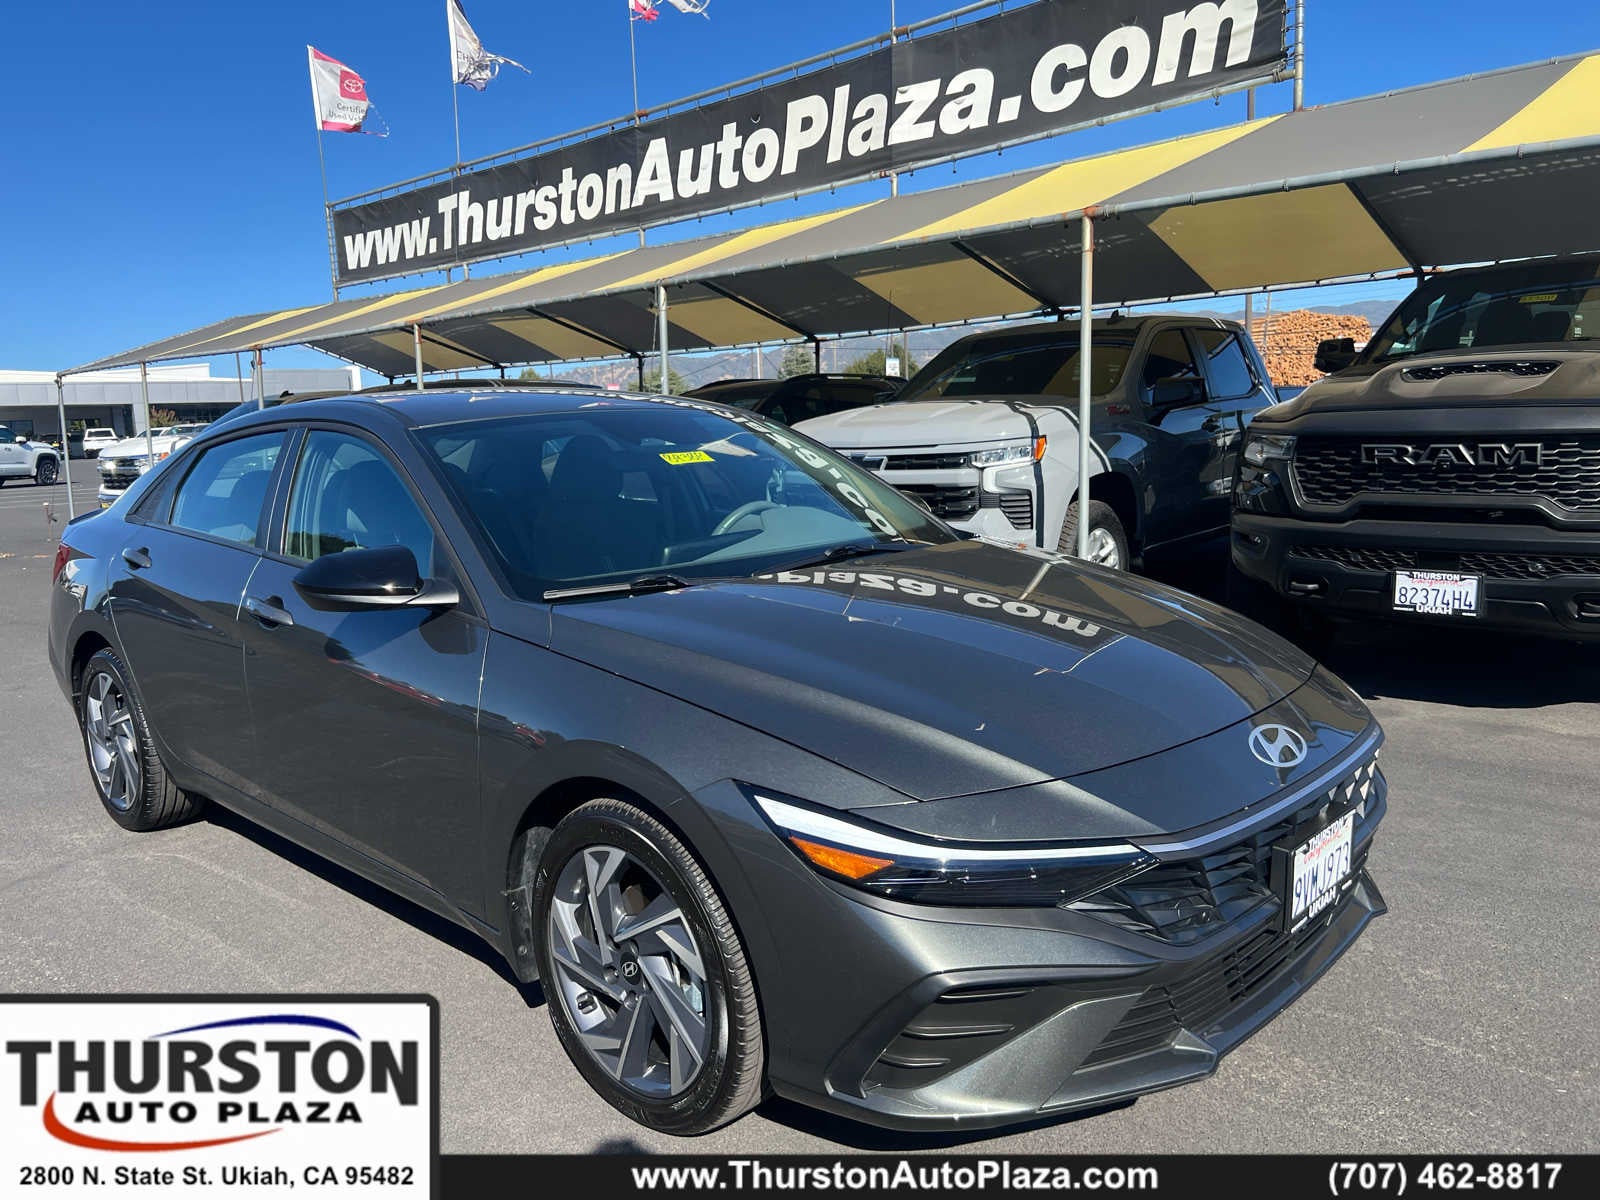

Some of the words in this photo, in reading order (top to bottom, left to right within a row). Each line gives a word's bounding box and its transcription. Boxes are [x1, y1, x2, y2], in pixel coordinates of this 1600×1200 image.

[343, 0, 1259, 271] www.ThurstonAutoPlaza.com
[1360, 443, 1544, 467] RAM
[1411, 571, 1460, 582] THURSTON
[1398, 586, 1473, 608] 82374H4
[1416, 604, 1453, 615] UKIAH
[1308, 816, 1345, 851] THURSTON
[1294, 841, 1350, 917] 9VMJ973
[1308, 886, 1337, 918] UKIAH
